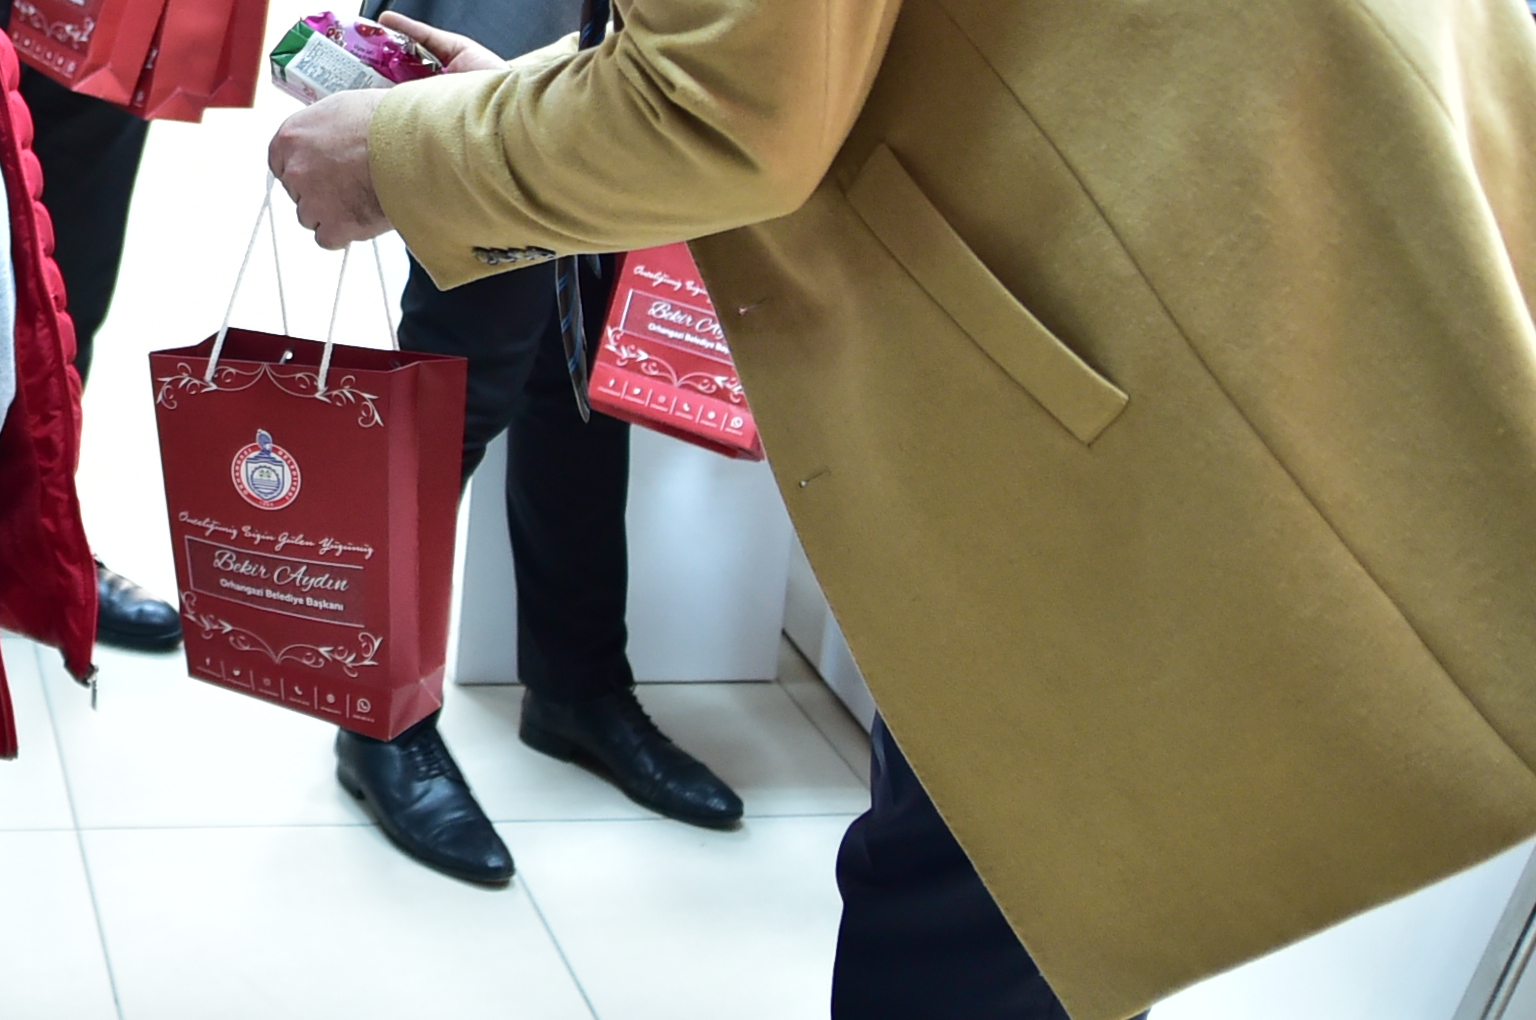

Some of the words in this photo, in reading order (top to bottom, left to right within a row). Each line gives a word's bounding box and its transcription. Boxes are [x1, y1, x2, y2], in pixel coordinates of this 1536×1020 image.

[648, 301, 695, 327] Bekir
[274, 532, 315, 551] Gülen
[213, 549, 270, 578] Bekir
[273, 565, 349, 592] Aydın
[220, 578, 263, 597] Orhangazi
[265, 589, 304, 605] Belediye
[306, 597, 344, 611] Başkanı
